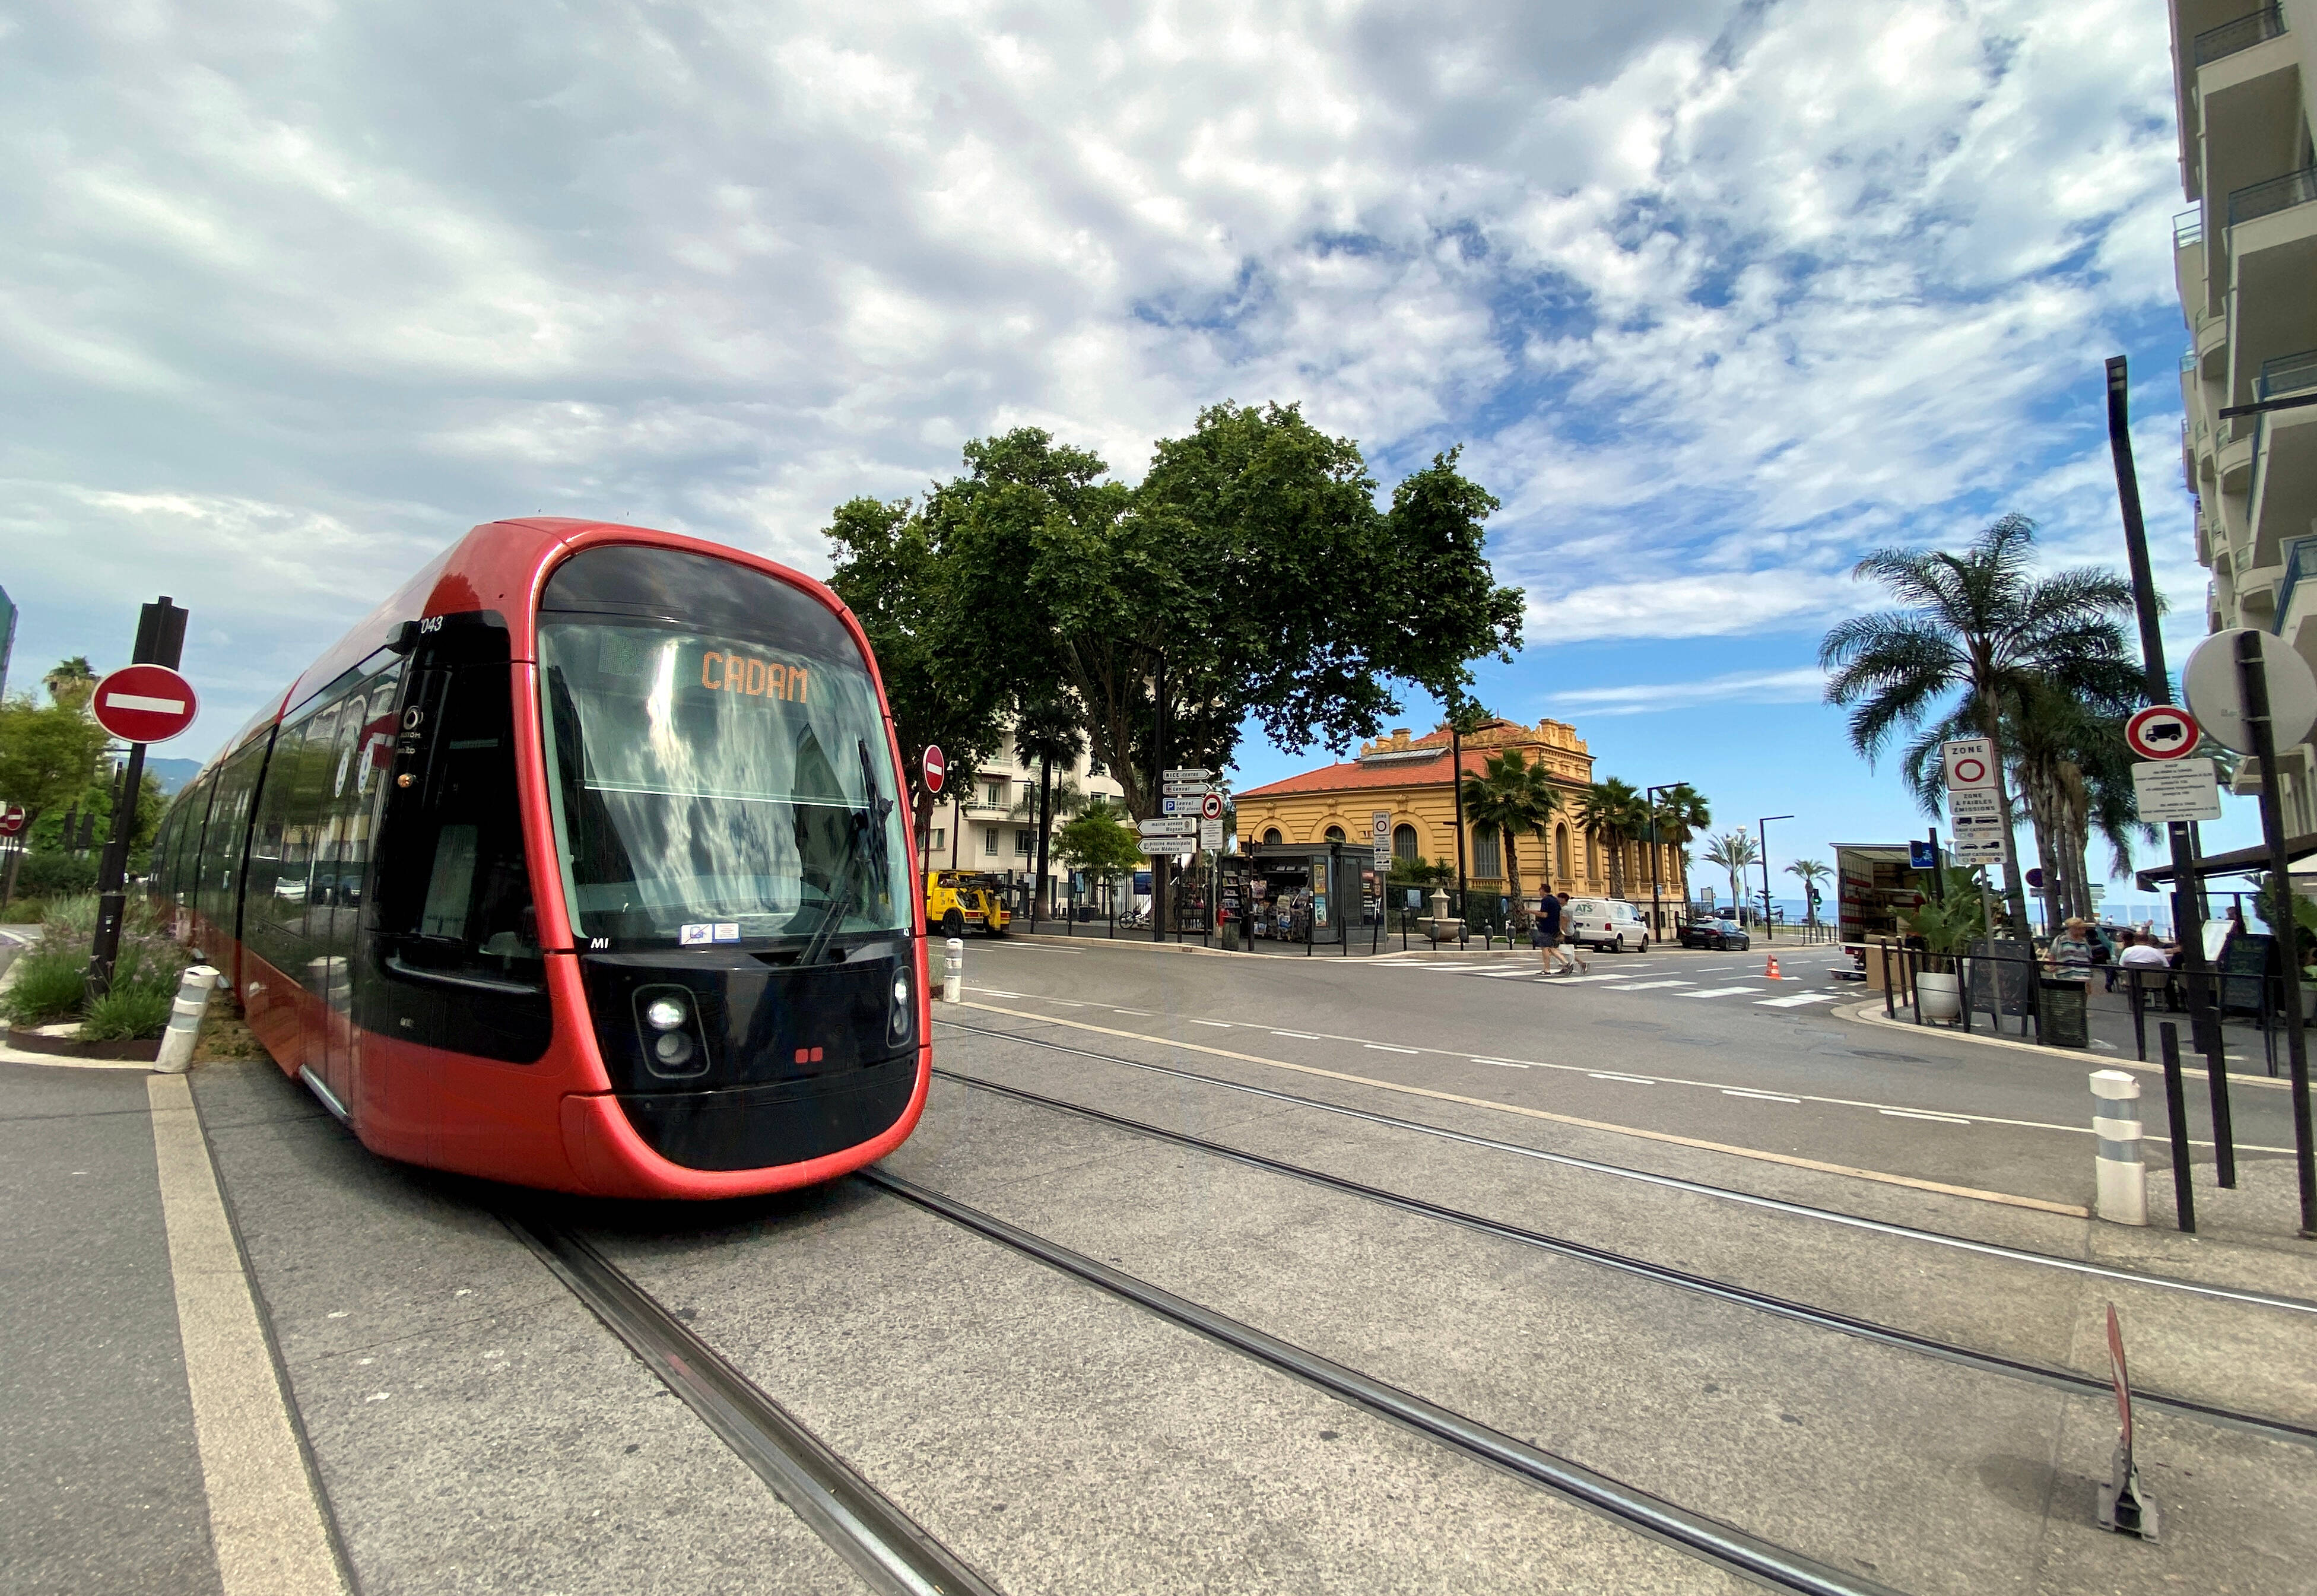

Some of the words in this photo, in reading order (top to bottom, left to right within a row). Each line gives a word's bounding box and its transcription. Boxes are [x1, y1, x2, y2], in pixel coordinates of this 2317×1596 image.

[421, 615, 443, 634] 043
[702, 651, 808, 703] CADAM
[1952, 745, 1983, 754] ZONE
[1167, 802, 1174, 810] P
